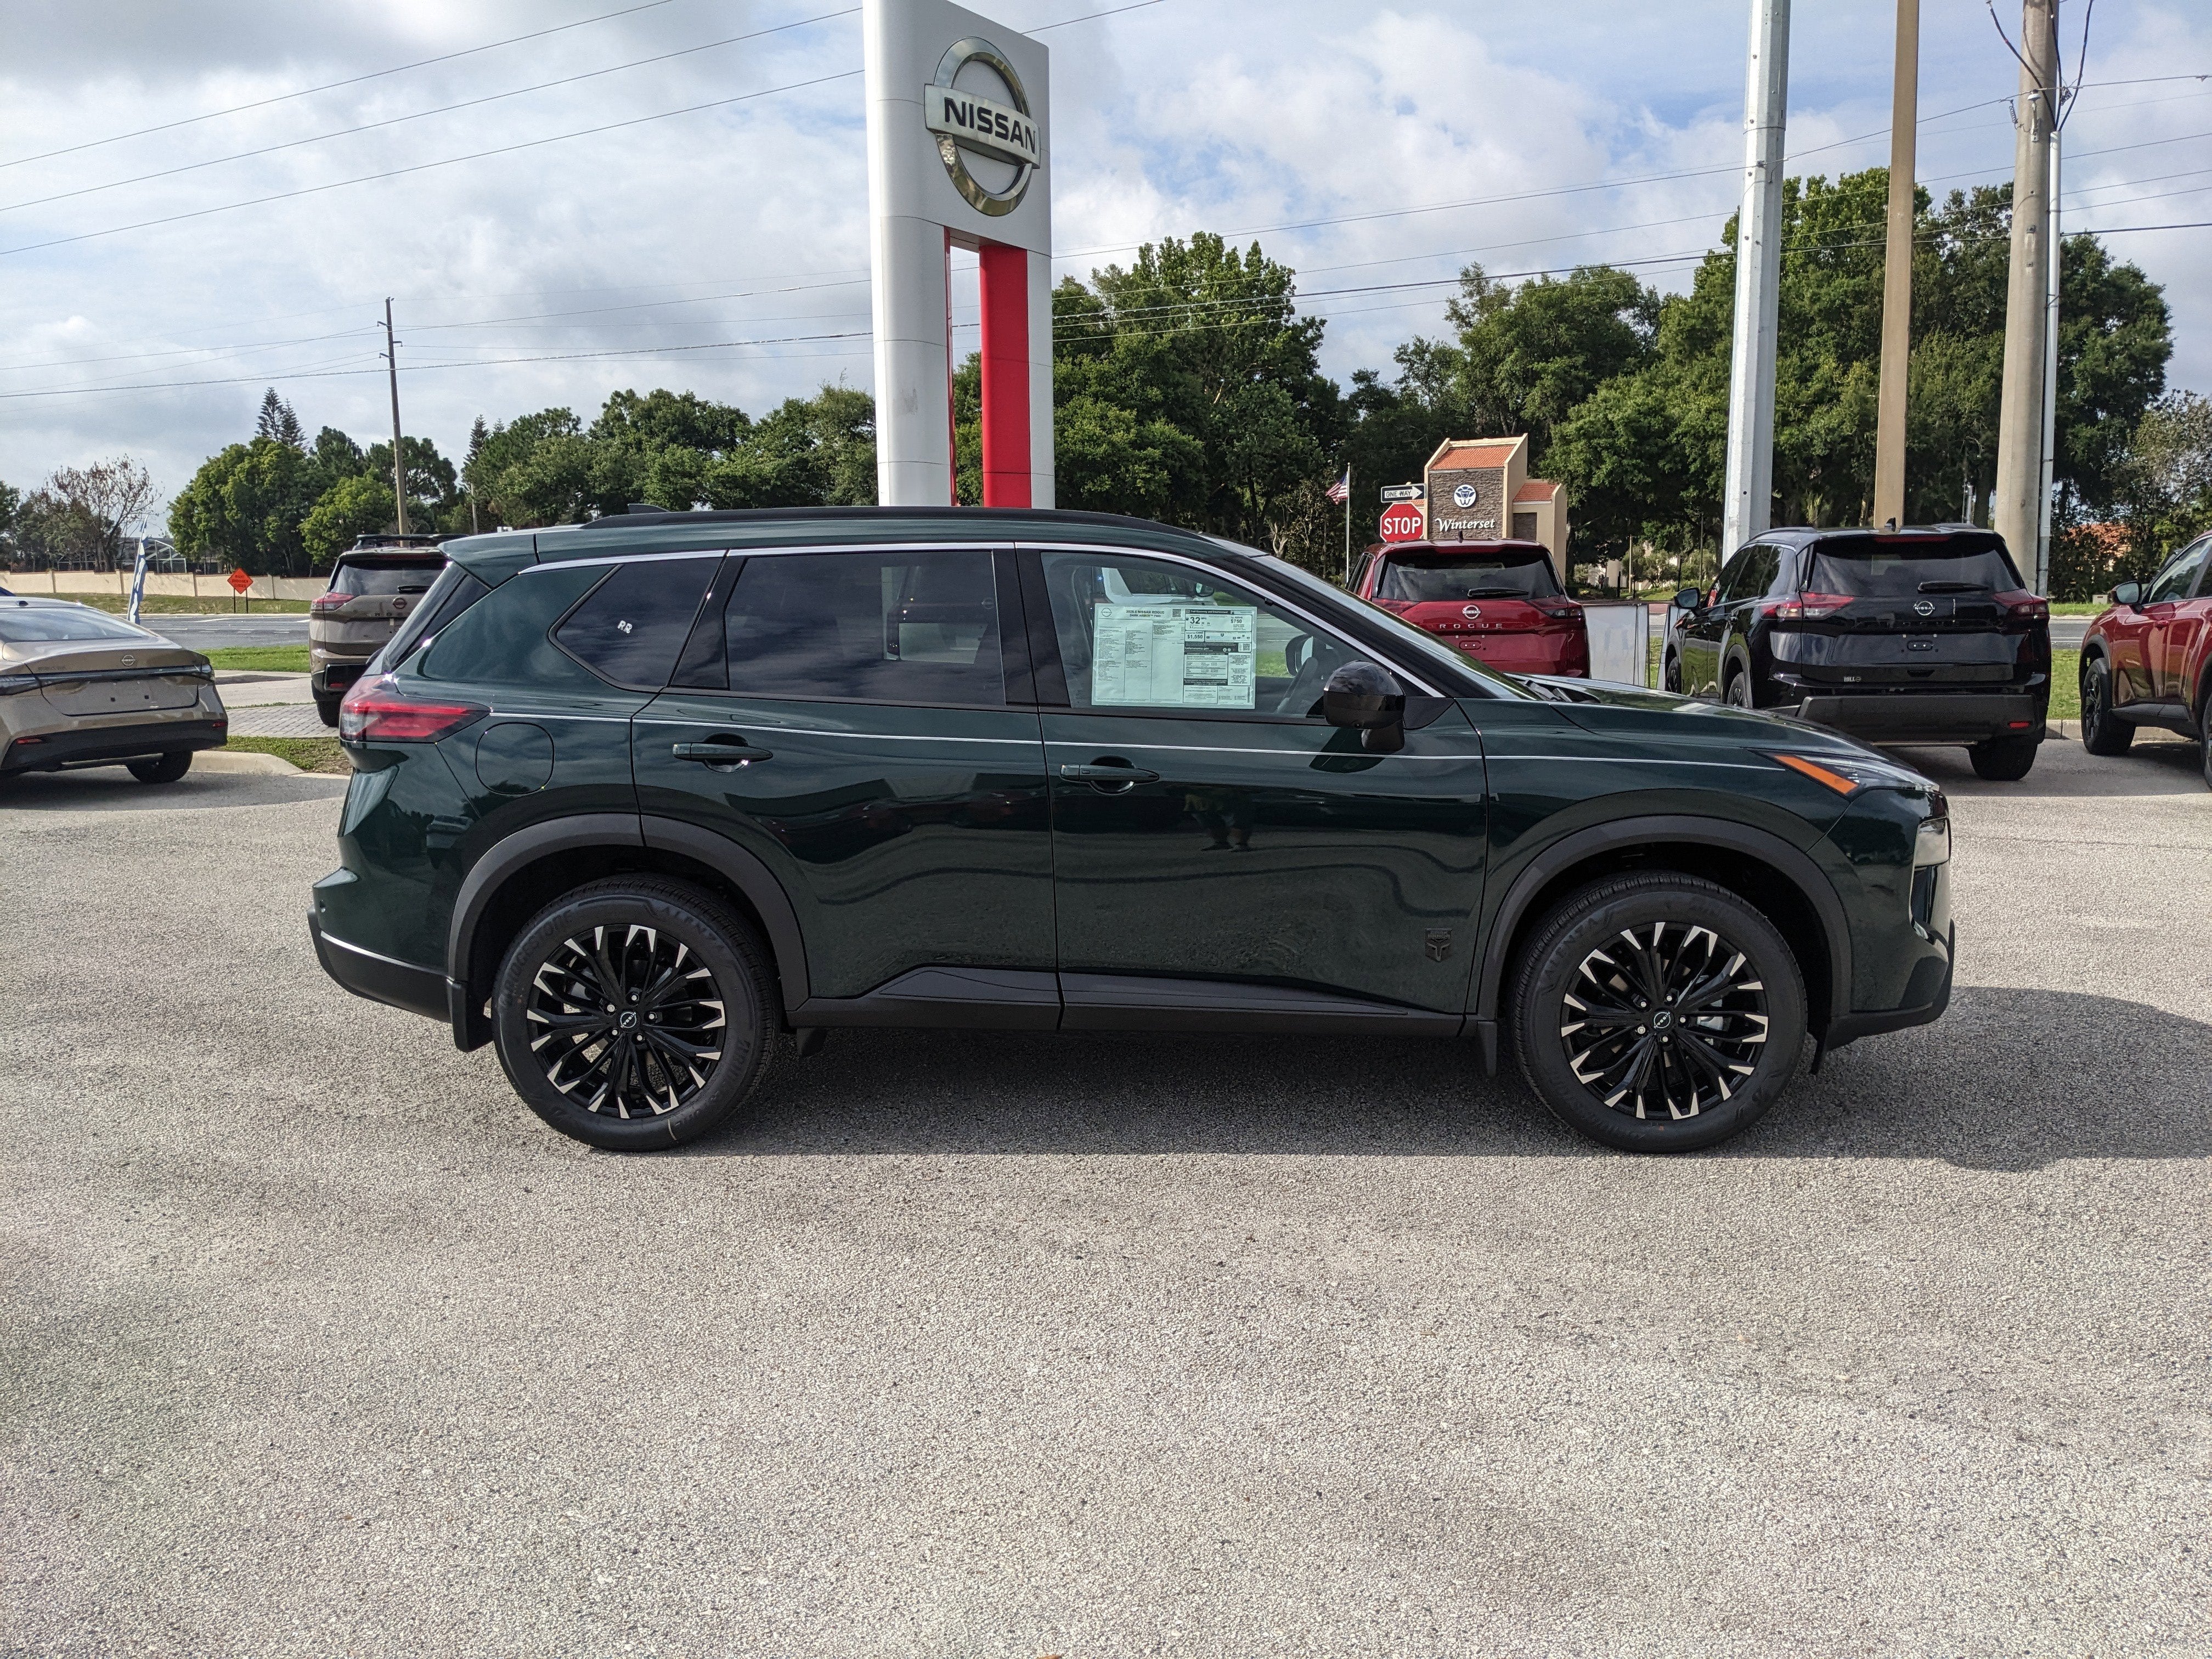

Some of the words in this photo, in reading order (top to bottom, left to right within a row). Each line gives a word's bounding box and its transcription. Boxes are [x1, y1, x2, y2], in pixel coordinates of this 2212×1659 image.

[944, 97, 1037, 155] NISSAN
[1383, 517, 1421, 535] STOP
[1435, 518, 1496, 532] Winterset
